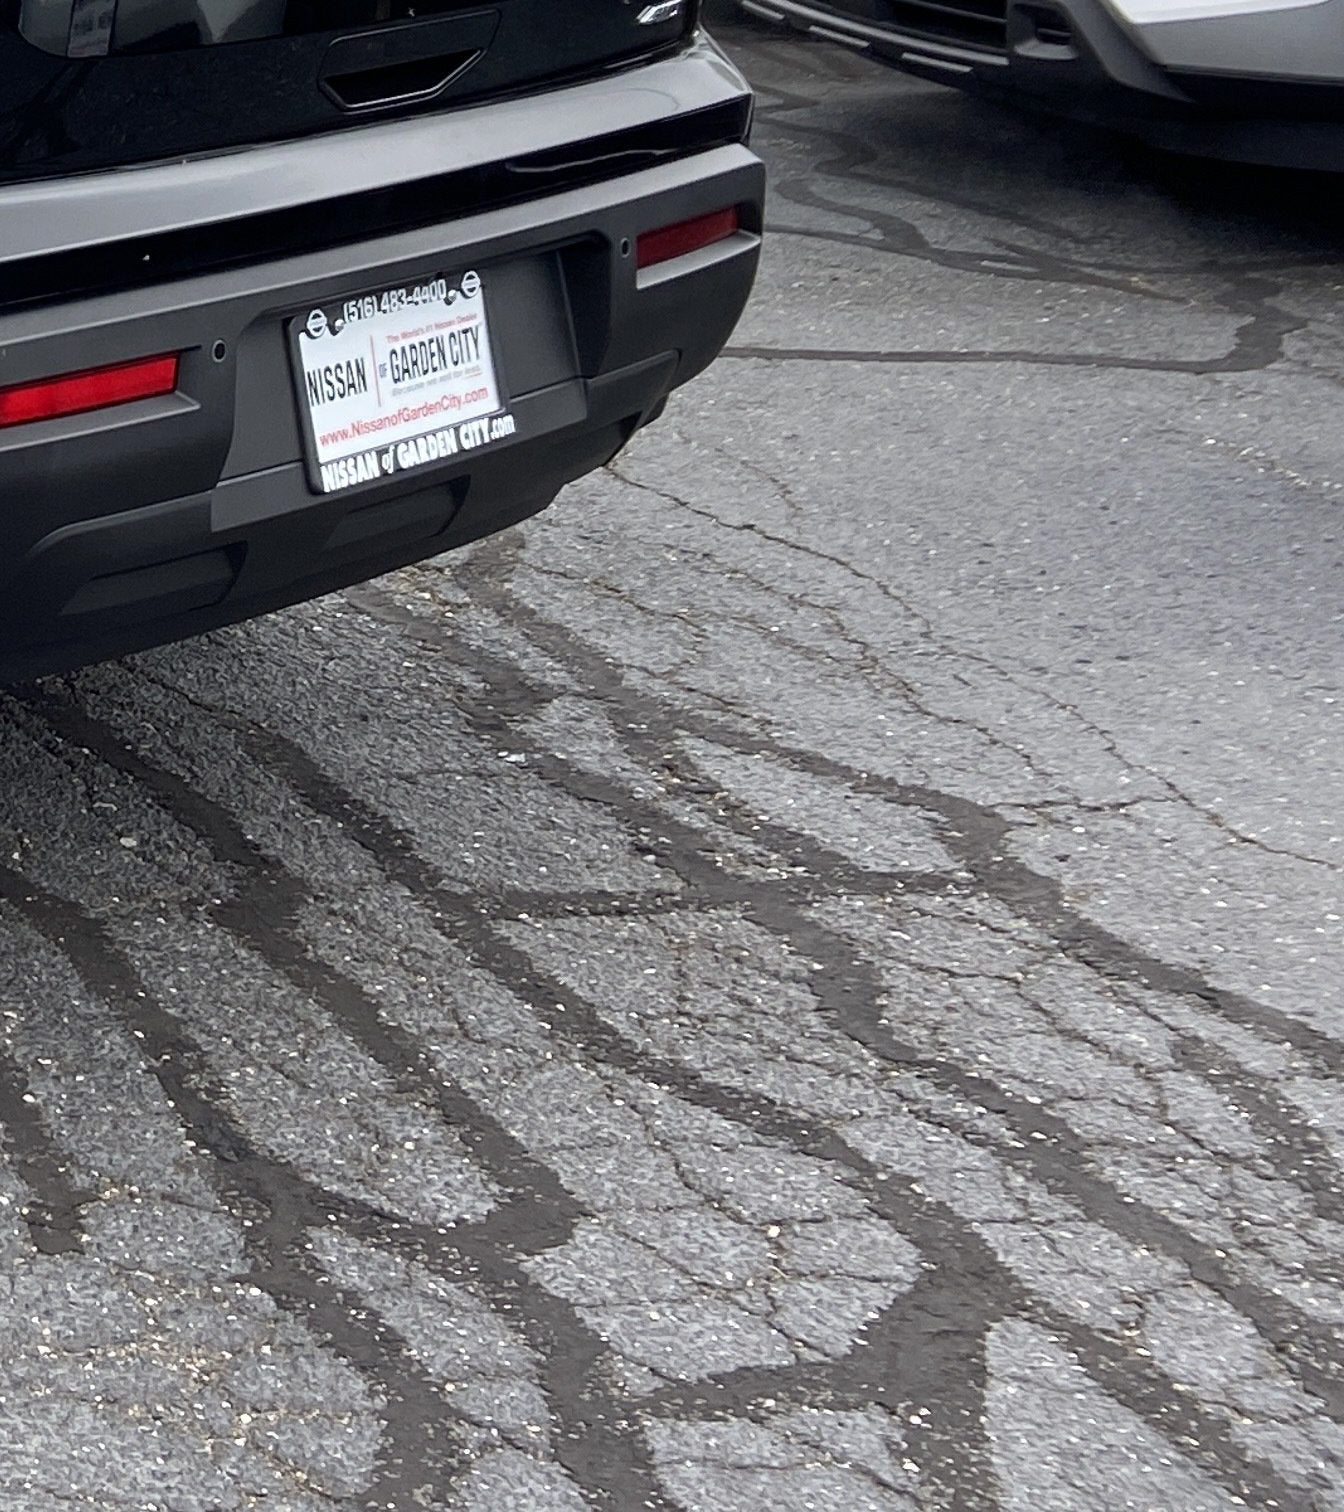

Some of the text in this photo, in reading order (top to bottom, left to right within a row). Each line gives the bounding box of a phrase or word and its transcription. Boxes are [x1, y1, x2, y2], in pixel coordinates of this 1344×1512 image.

[343, 296, 378, 324] (516)
[306, 357, 368, 407] NISSAN
[389, 334, 448, 385] GARDEN
[448, 324, 480, 367] CITY
[319, 387, 489, 446] www.NissanofGardenCity.com
[320, 413, 516, 493] NISSAN of GARDEN CITY.com
